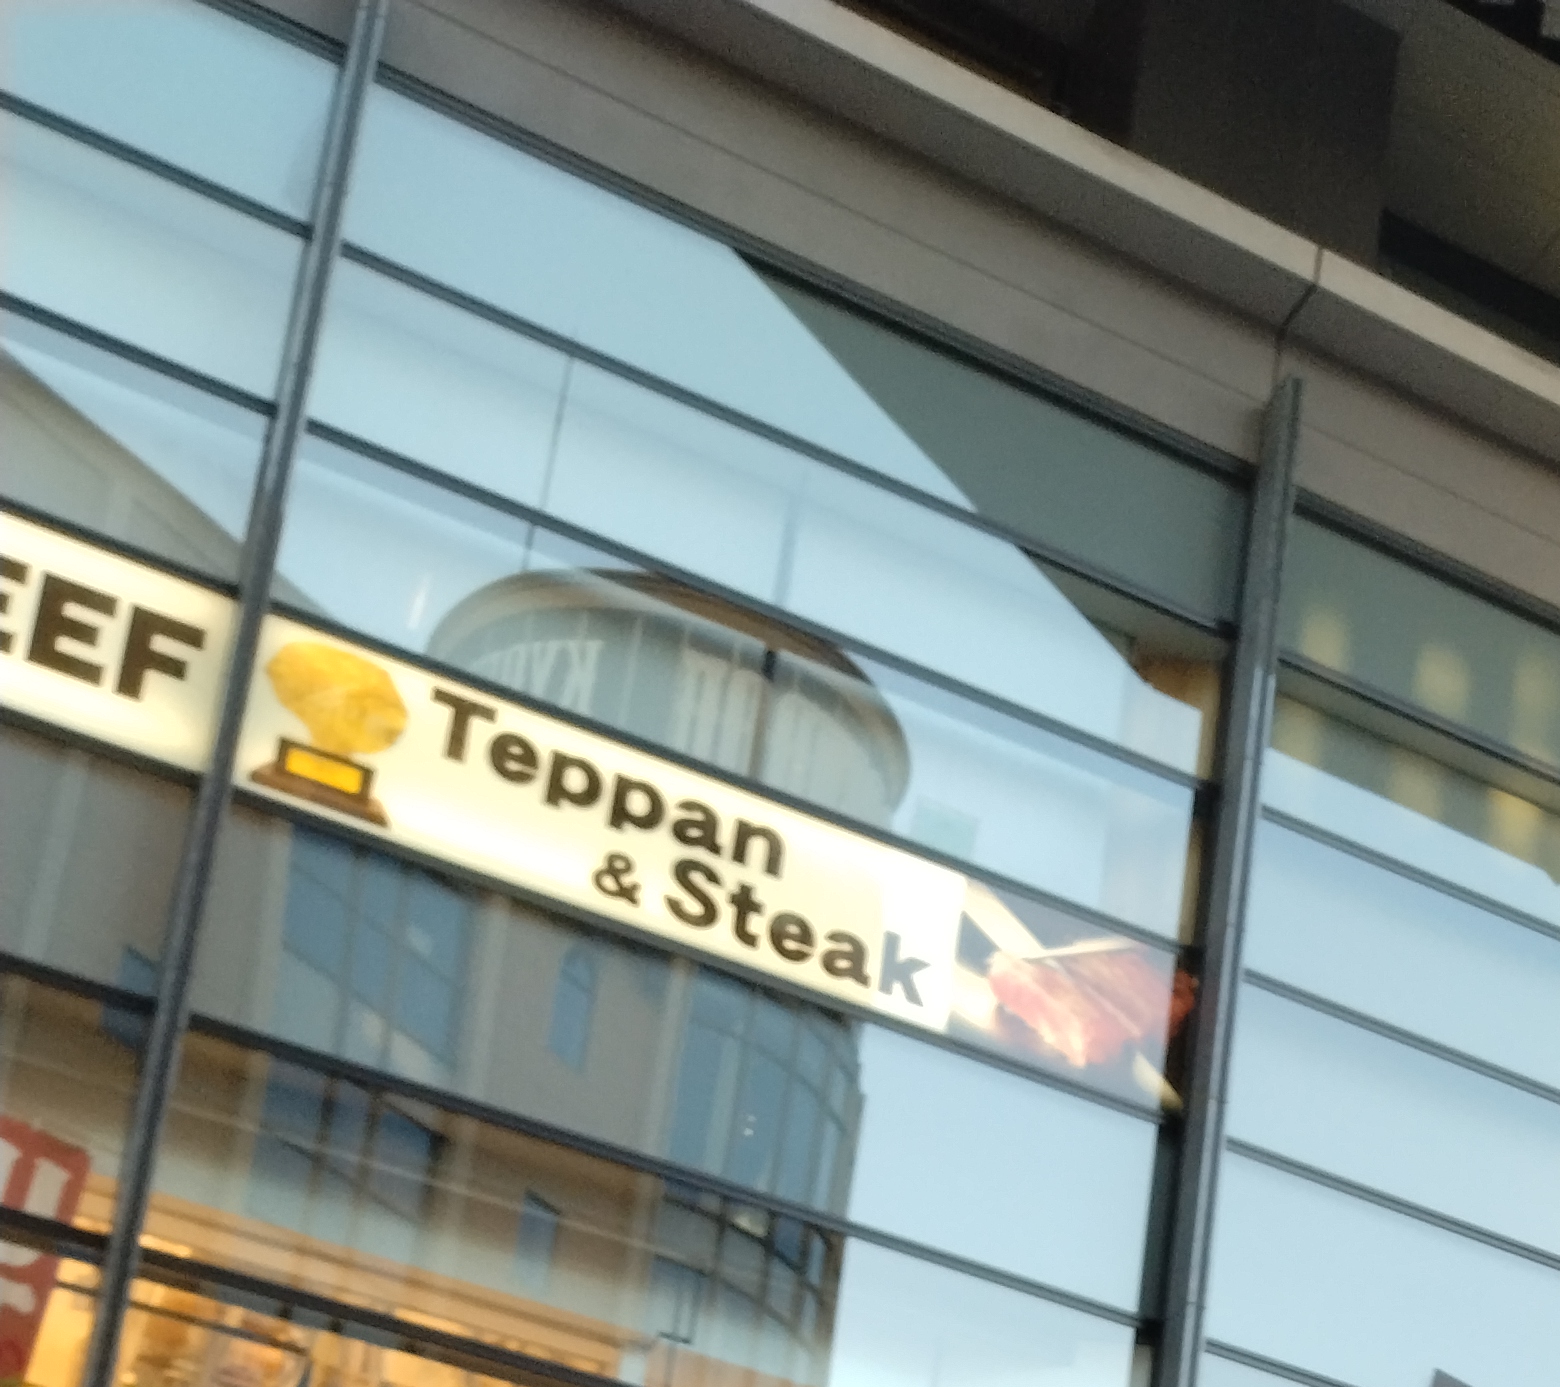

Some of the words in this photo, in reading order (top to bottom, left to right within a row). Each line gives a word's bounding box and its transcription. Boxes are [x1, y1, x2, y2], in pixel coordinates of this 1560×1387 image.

[432, 687, 785, 879] Teppan
[593, 851, 641, 905] &
[664, 857, 931, 1008] Steak
